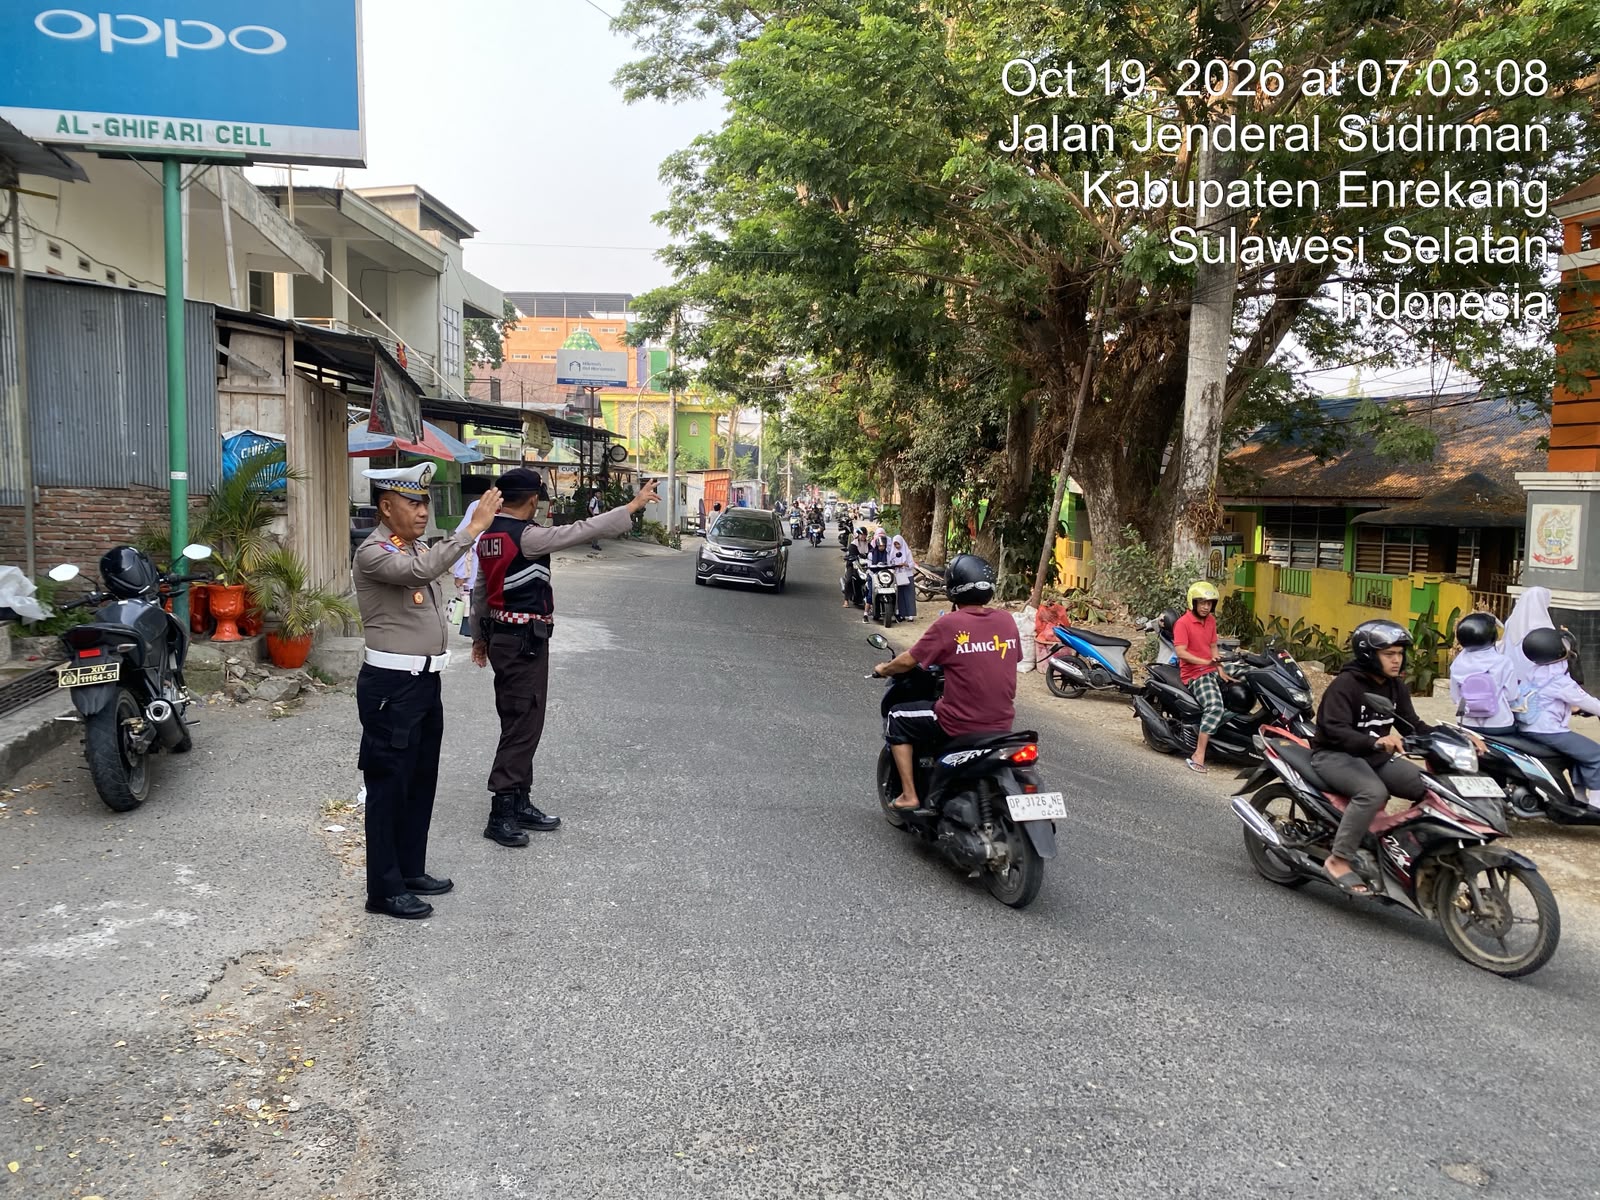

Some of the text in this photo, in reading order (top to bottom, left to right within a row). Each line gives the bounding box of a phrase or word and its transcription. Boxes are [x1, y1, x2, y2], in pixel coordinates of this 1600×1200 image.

[56, 114, 272, 147] AL-GHIFARI CELL
[479, 538, 502, 556] POLISI
[91, 665, 107, 673] XIV
[80, 672, 117, 683] 11164-51
[1025, 796, 1047, 807] 3126
[1050, 795, 1062, 805] NE
